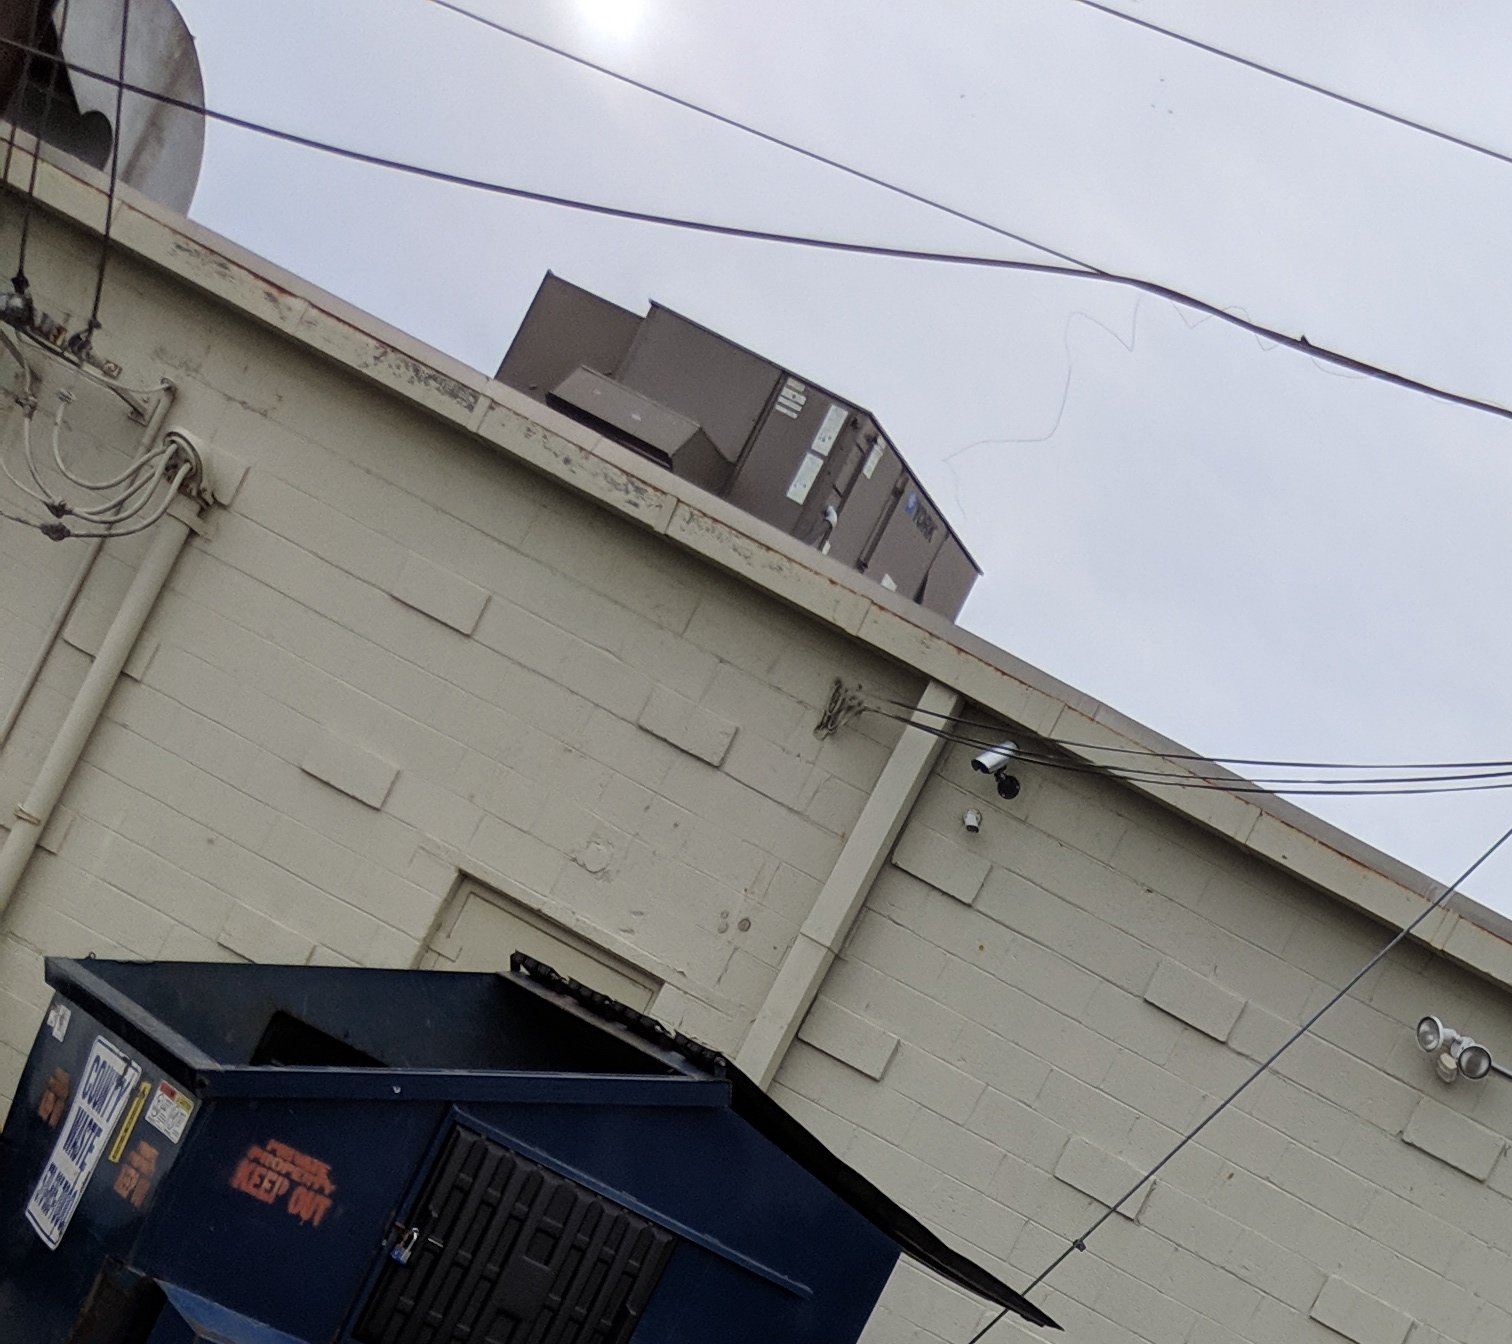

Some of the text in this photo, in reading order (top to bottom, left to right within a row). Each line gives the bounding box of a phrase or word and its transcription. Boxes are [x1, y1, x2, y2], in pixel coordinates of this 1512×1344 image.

[82, 1054, 135, 1123] COUNTY
[63, 1105, 103, 1172] WASTE
[231, 1158, 333, 1226] KEEP OUT
